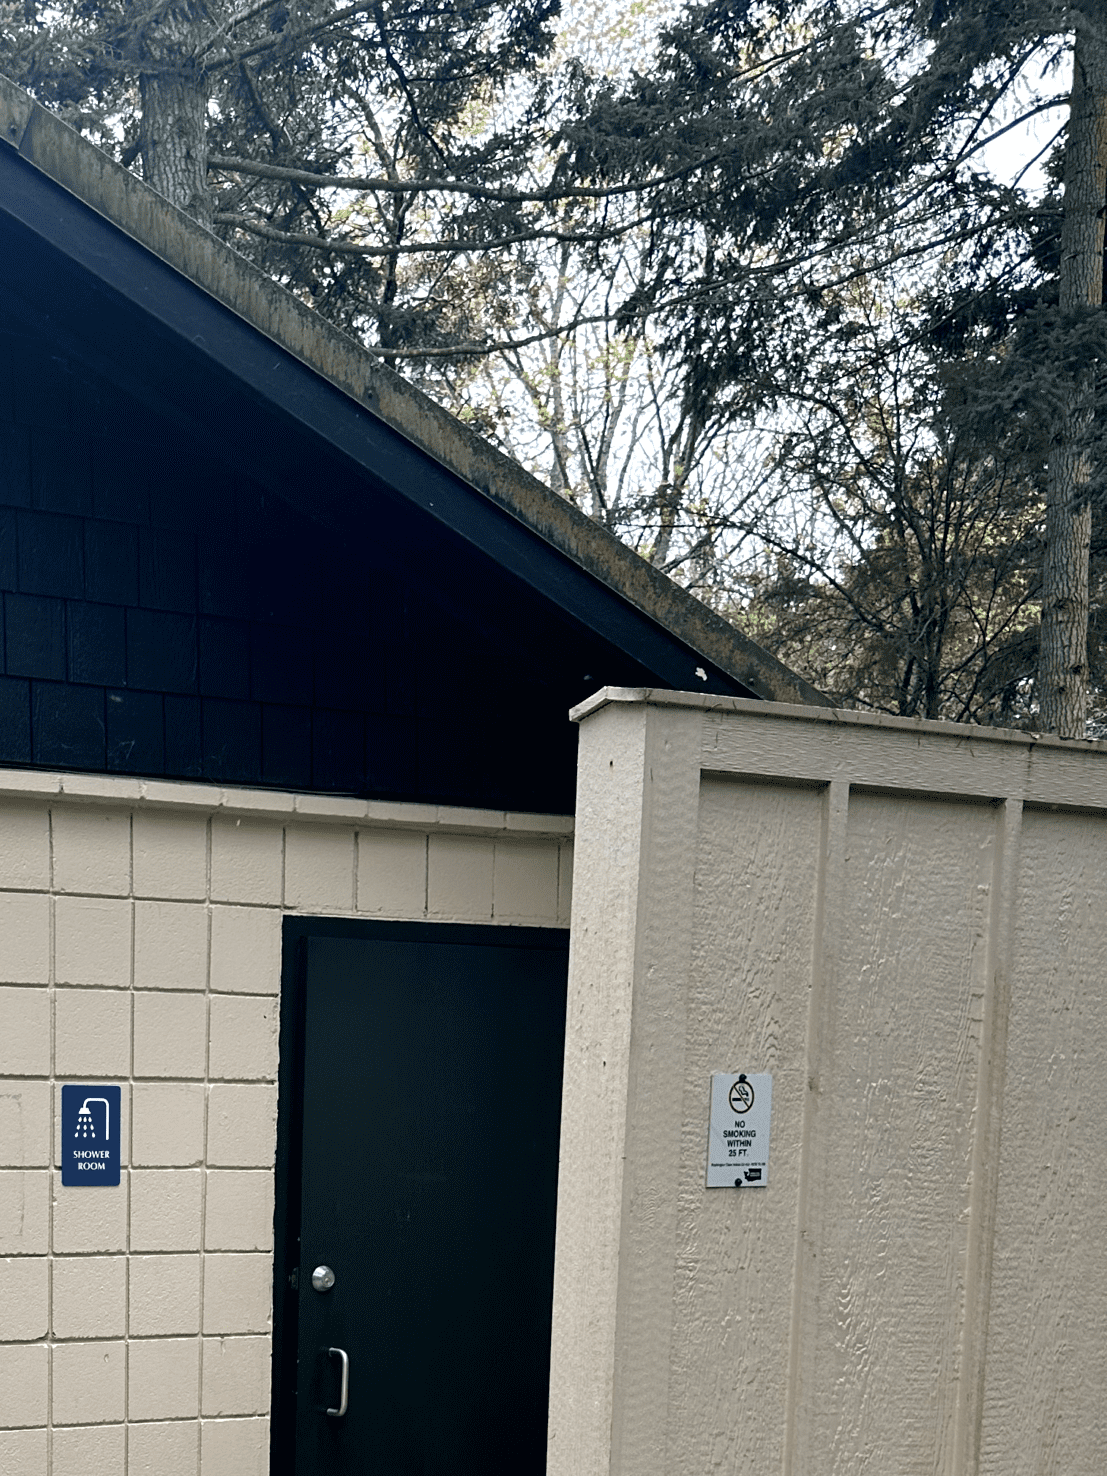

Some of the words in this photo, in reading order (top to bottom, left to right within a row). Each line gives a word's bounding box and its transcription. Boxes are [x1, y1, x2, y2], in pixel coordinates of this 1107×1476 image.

[734, 1120, 746, 1128] NO
[723, 1130, 756, 1138] SMOKING
[73, 1150, 110, 1159] SHOWER
[728, 1149, 737, 1157] 25
[78, 1162, 106, 1170] ROOM
